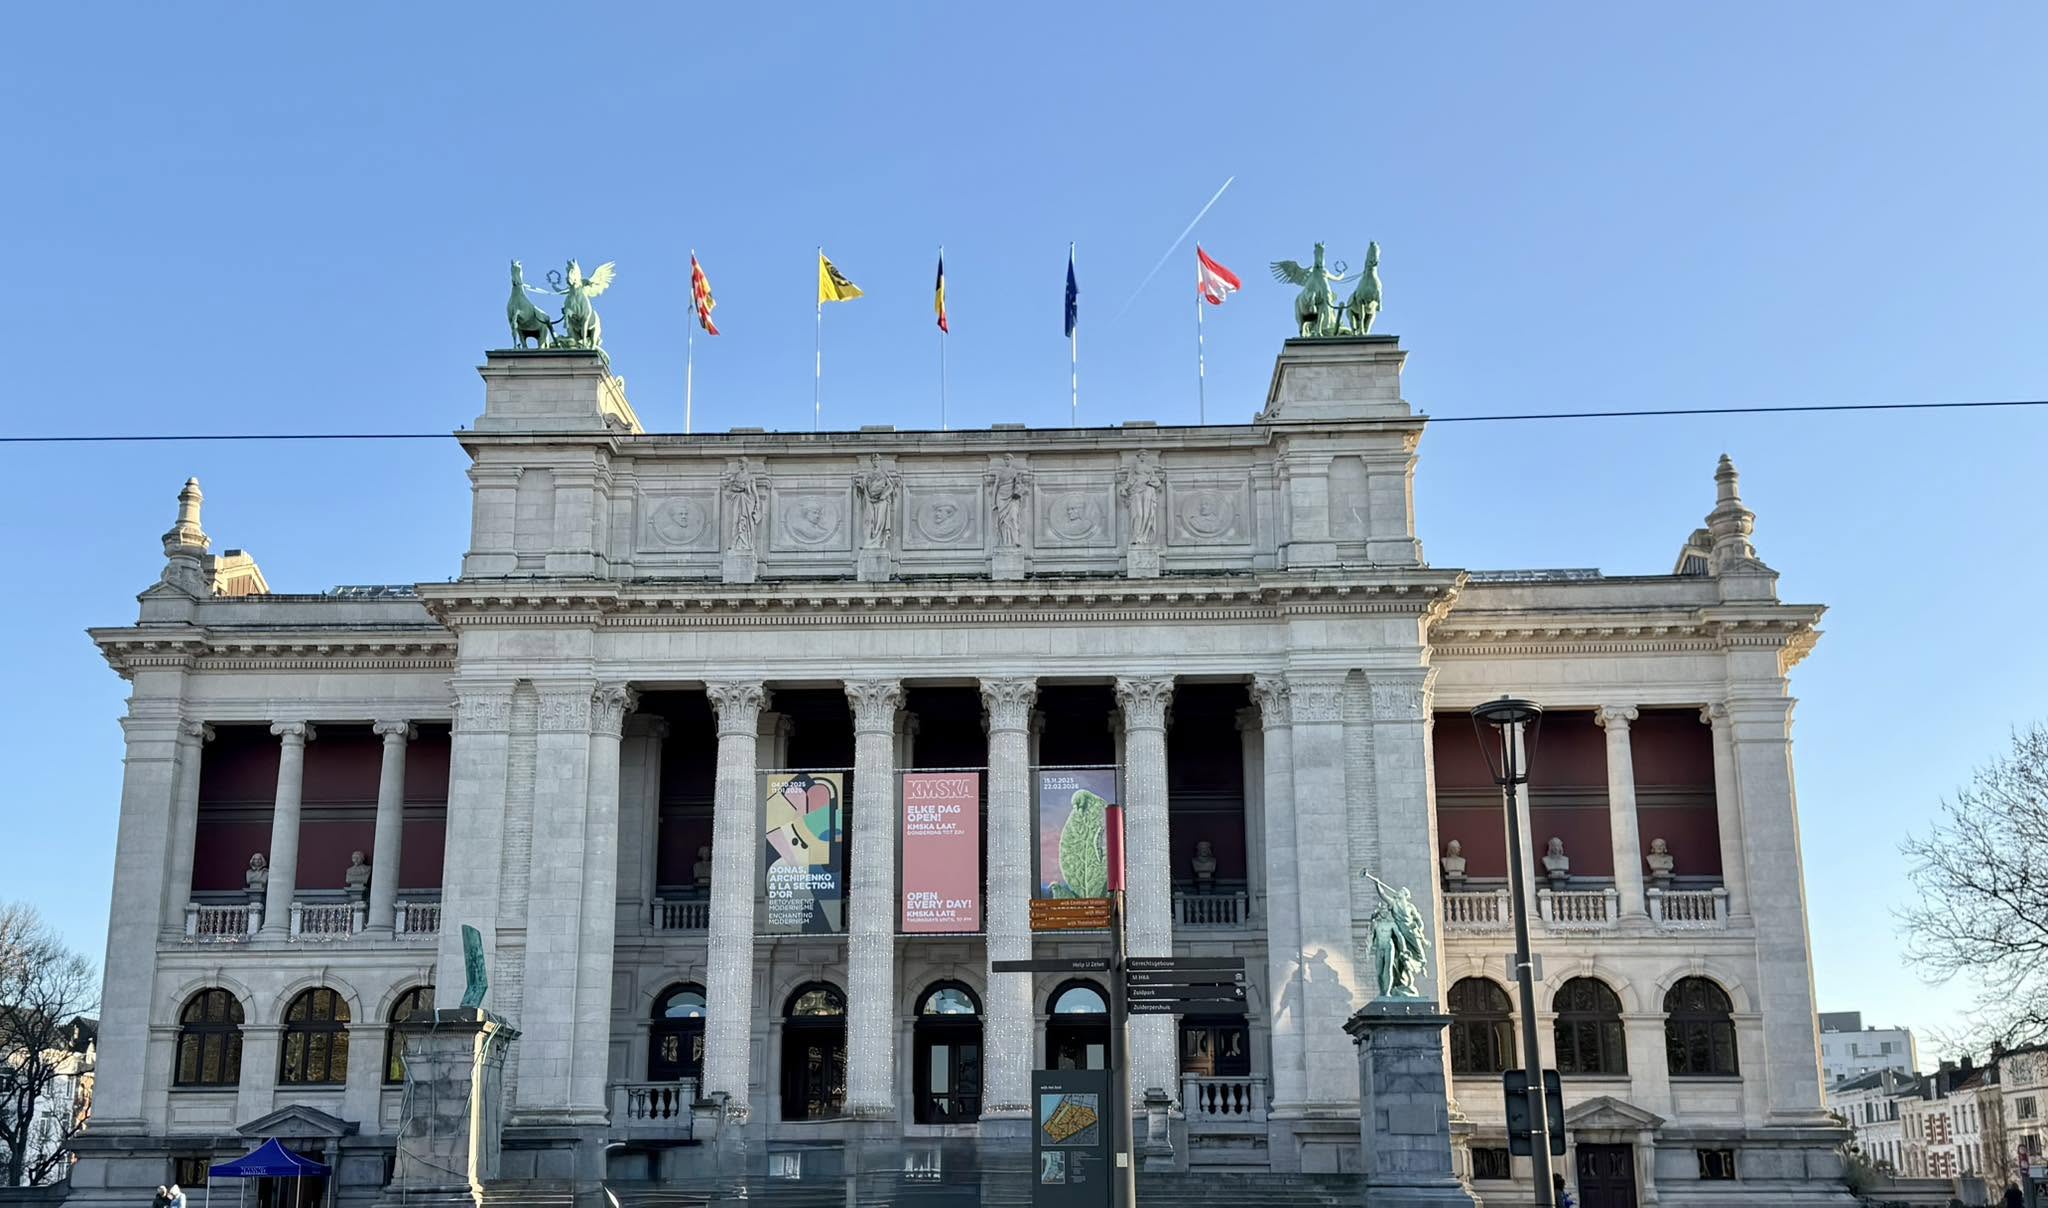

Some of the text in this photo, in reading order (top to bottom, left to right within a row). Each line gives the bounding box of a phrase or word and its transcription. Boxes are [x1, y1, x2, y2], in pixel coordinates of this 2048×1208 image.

[907, 779, 974, 799] KMSKA
[907, 804, 961, 814] ELKE DAG
[907, 813, 941, 822] OPEN!
[770, 866, 807, 874] DONAS,
[769, 873, 832, 882] ARCHIPENKO
[769, 881, 835, 890] & LA SECTION
[769, 890, 793, 899] D'OR
[907, 891, 938, 900] OPEN
[907, 899, 972, 909] EVERY DAY!
